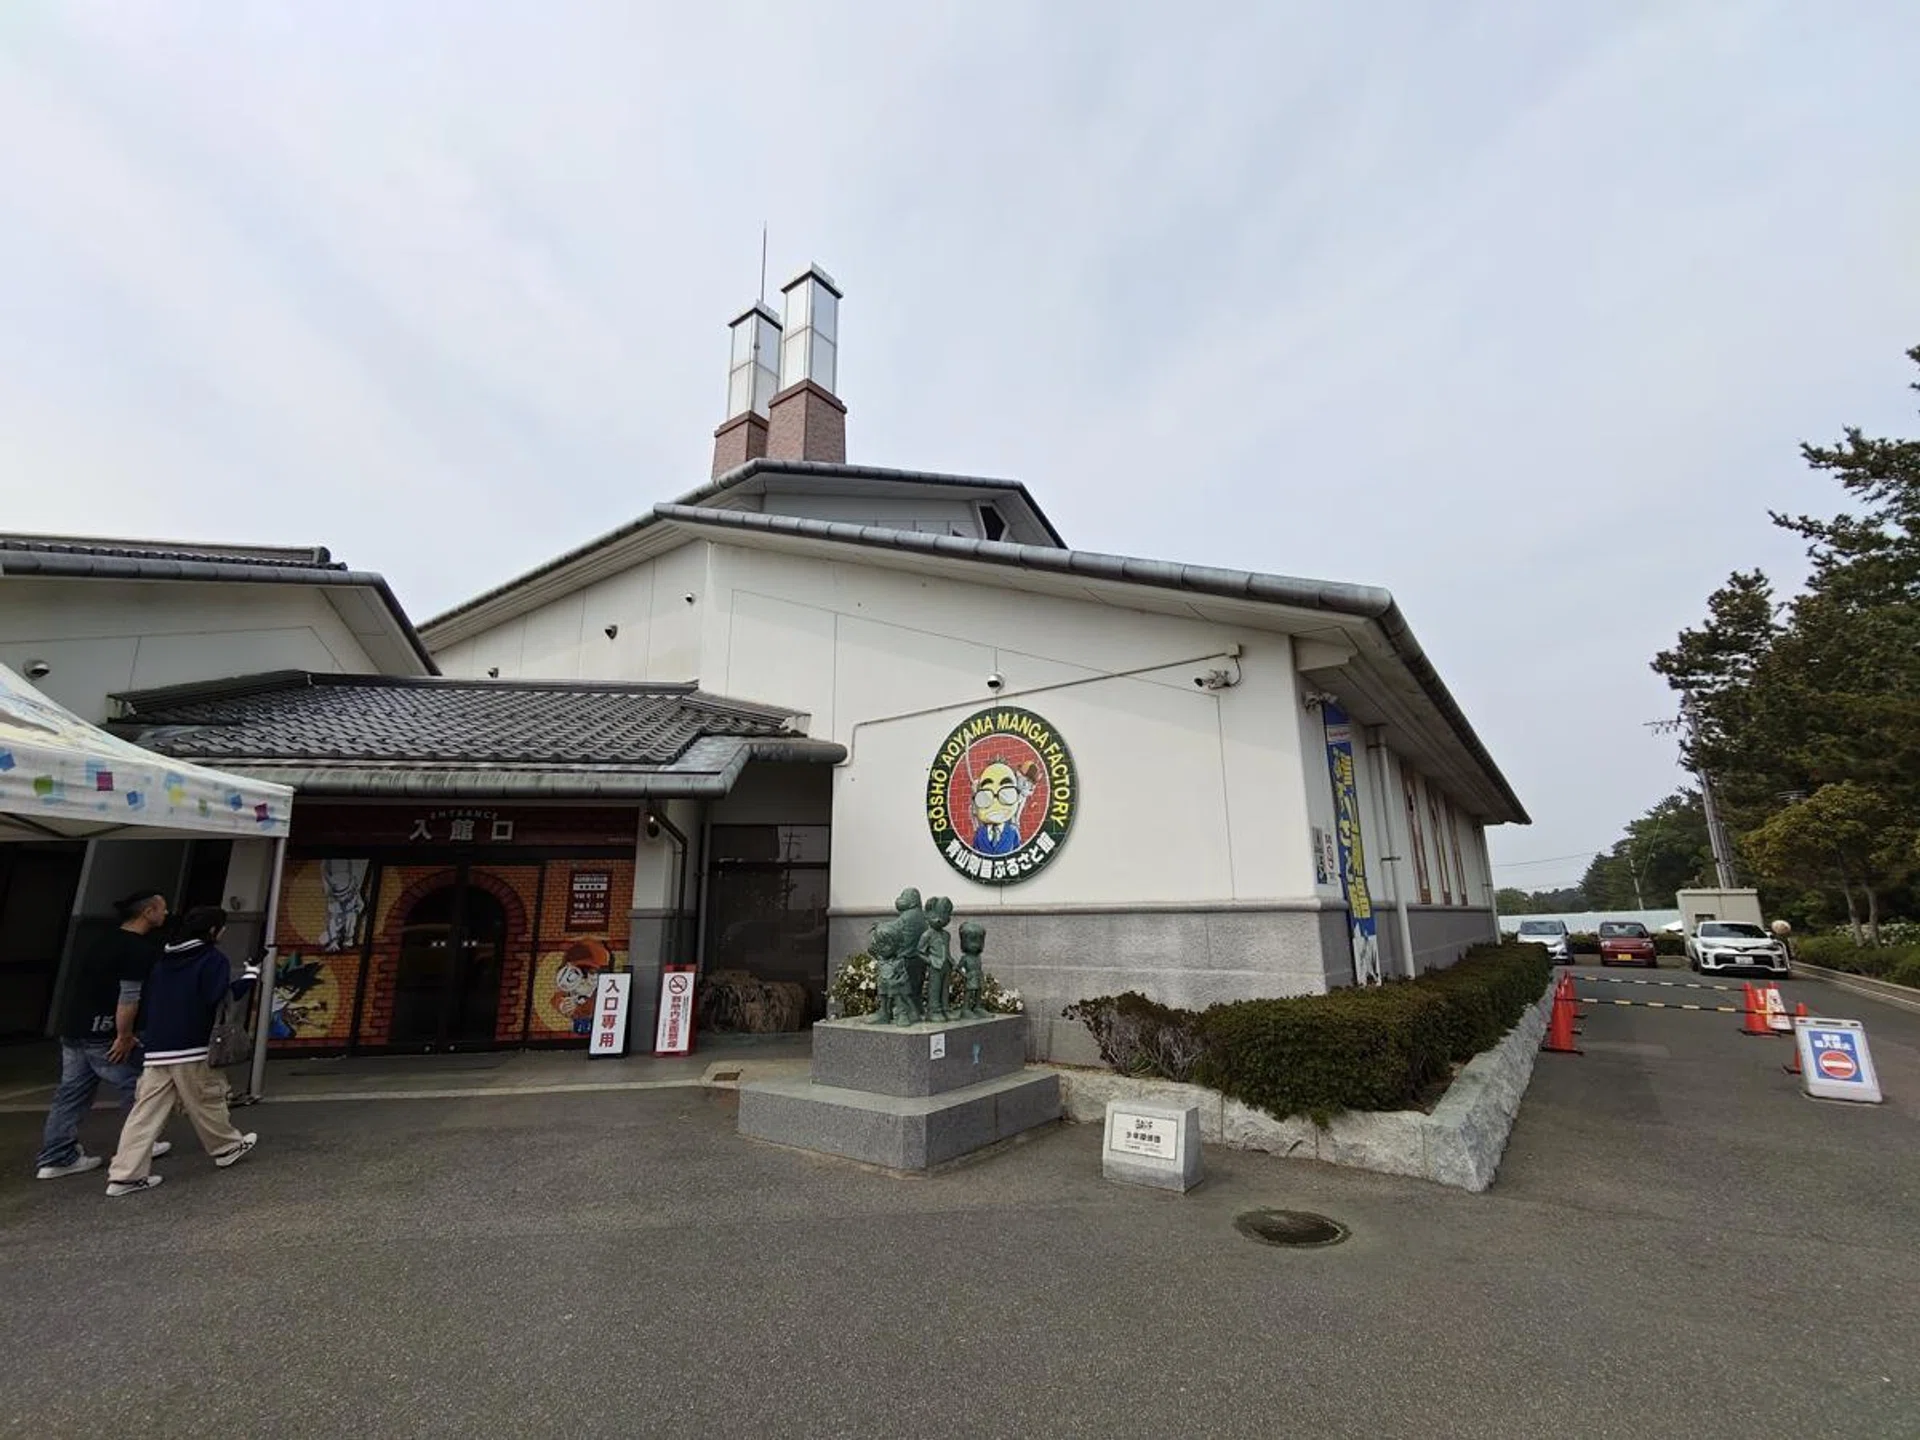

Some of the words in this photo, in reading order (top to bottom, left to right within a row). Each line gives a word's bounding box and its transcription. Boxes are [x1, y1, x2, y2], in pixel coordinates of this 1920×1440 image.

[942, 715, 994, 766] AOYAMA
[996, 713, 1049, 748] MANGA
[1043, 742, 1071, 827] FACTORY
[409, 819, 514, 841] 入館口
[598, 979, 620, 1047] 入口専用
